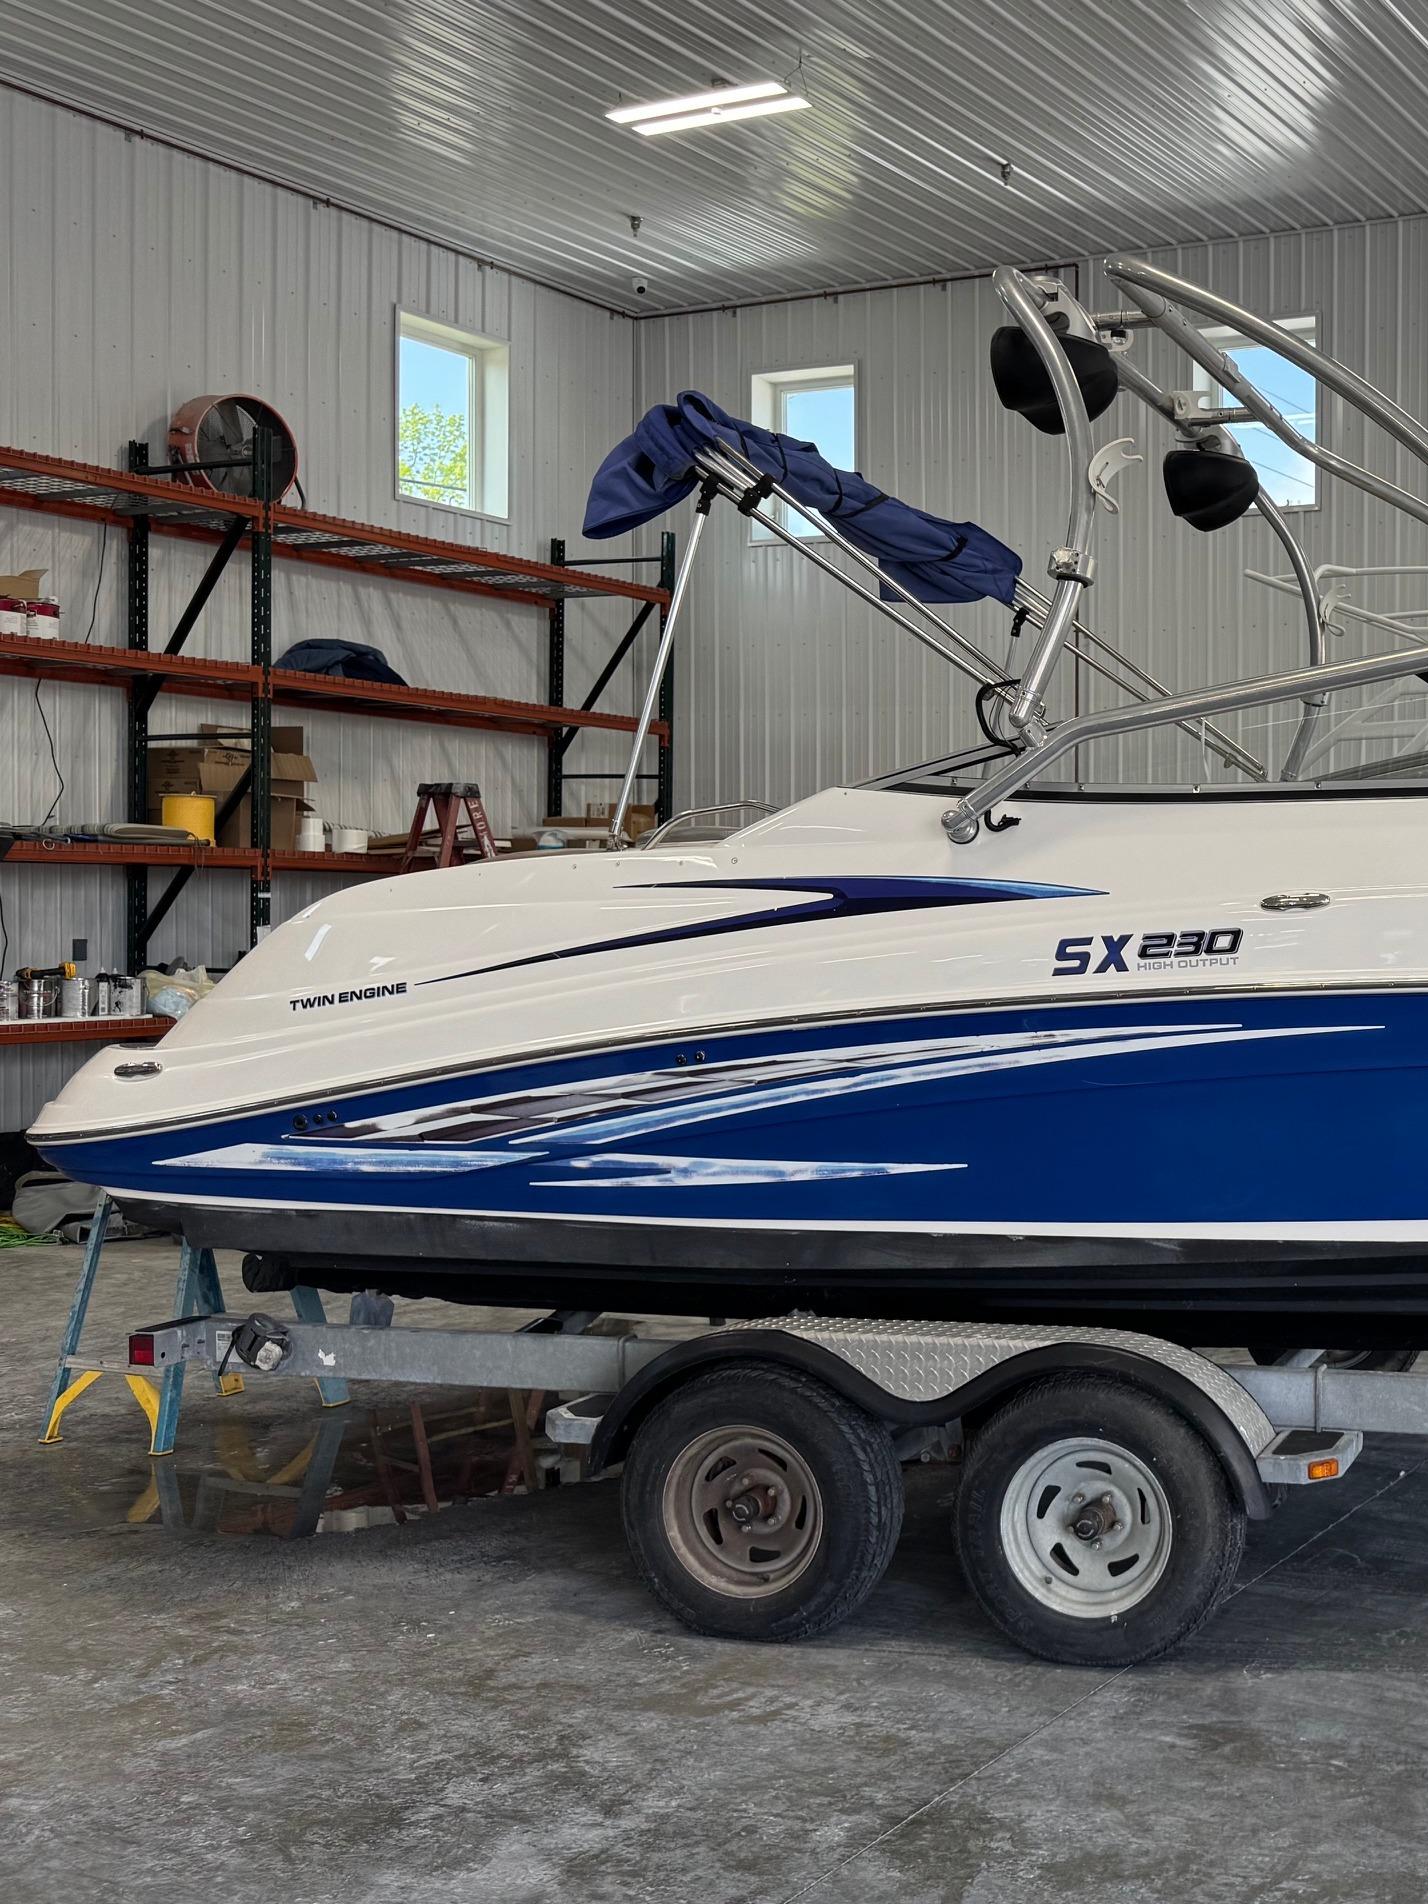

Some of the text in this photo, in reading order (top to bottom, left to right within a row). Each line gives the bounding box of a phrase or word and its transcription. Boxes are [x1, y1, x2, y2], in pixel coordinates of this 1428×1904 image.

[1052, 927, 1244, 977] SX 230
[1137, 957, 1239, 971] HIGH OUTPUT
[289, 982, 408, 1011] TWIN ENGINE
